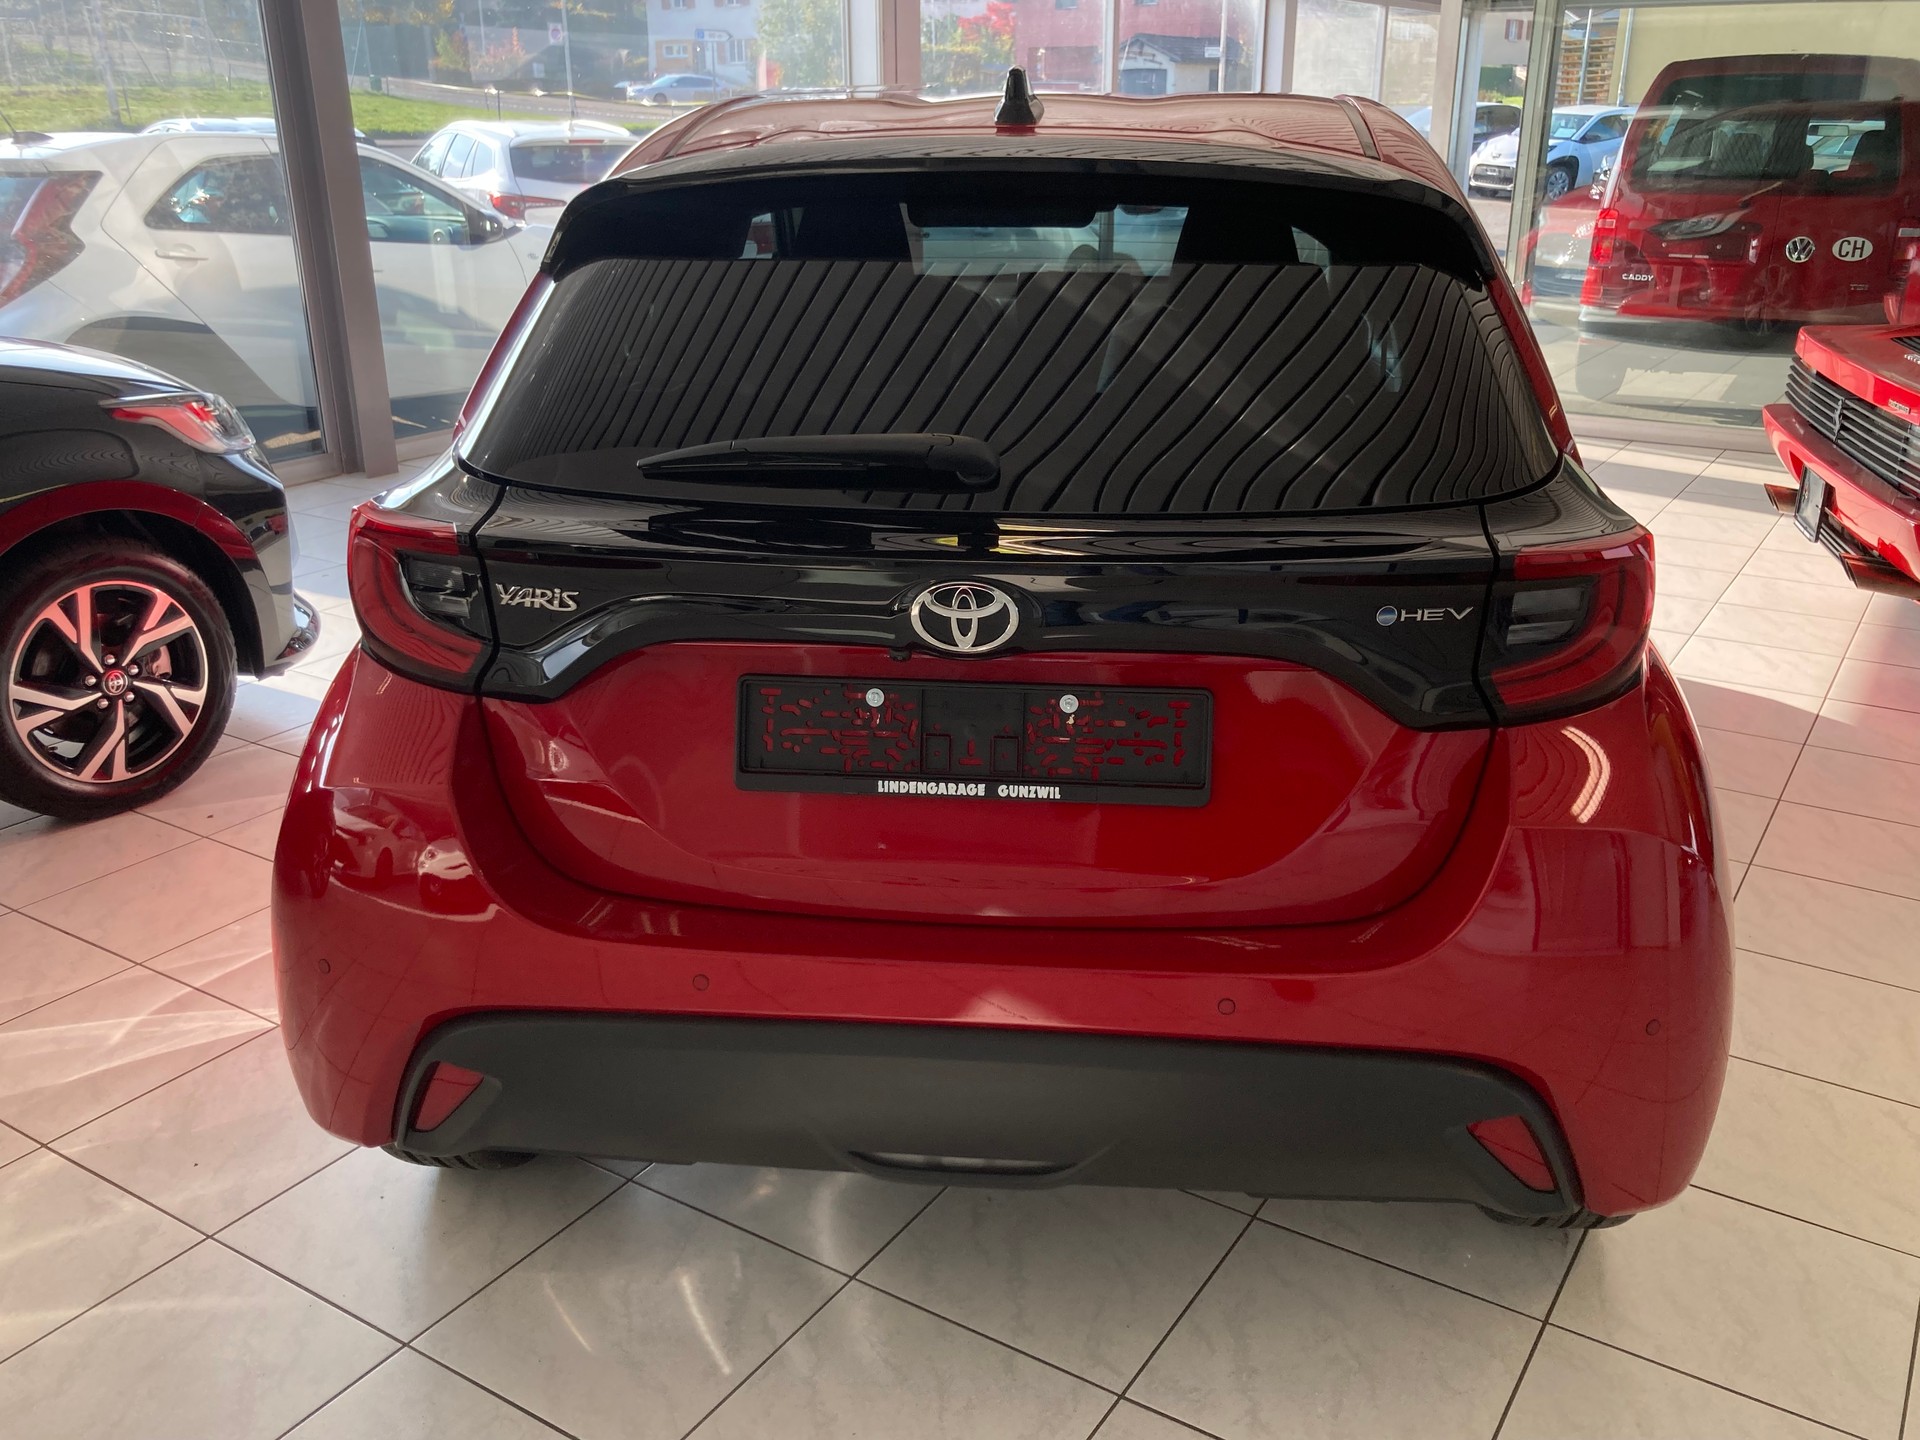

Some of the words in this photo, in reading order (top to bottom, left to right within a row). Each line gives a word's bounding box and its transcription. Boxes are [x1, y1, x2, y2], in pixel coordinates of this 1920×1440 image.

[1838, 239, 1866, 258] CH
[1621, 272, 1654, 282] CADDY
[1400, 606, 1474, 622] HEV
[877, 780, 986, 796] LINDENGARAGE
[997, 785, 1061, 799] GUNZWIL
